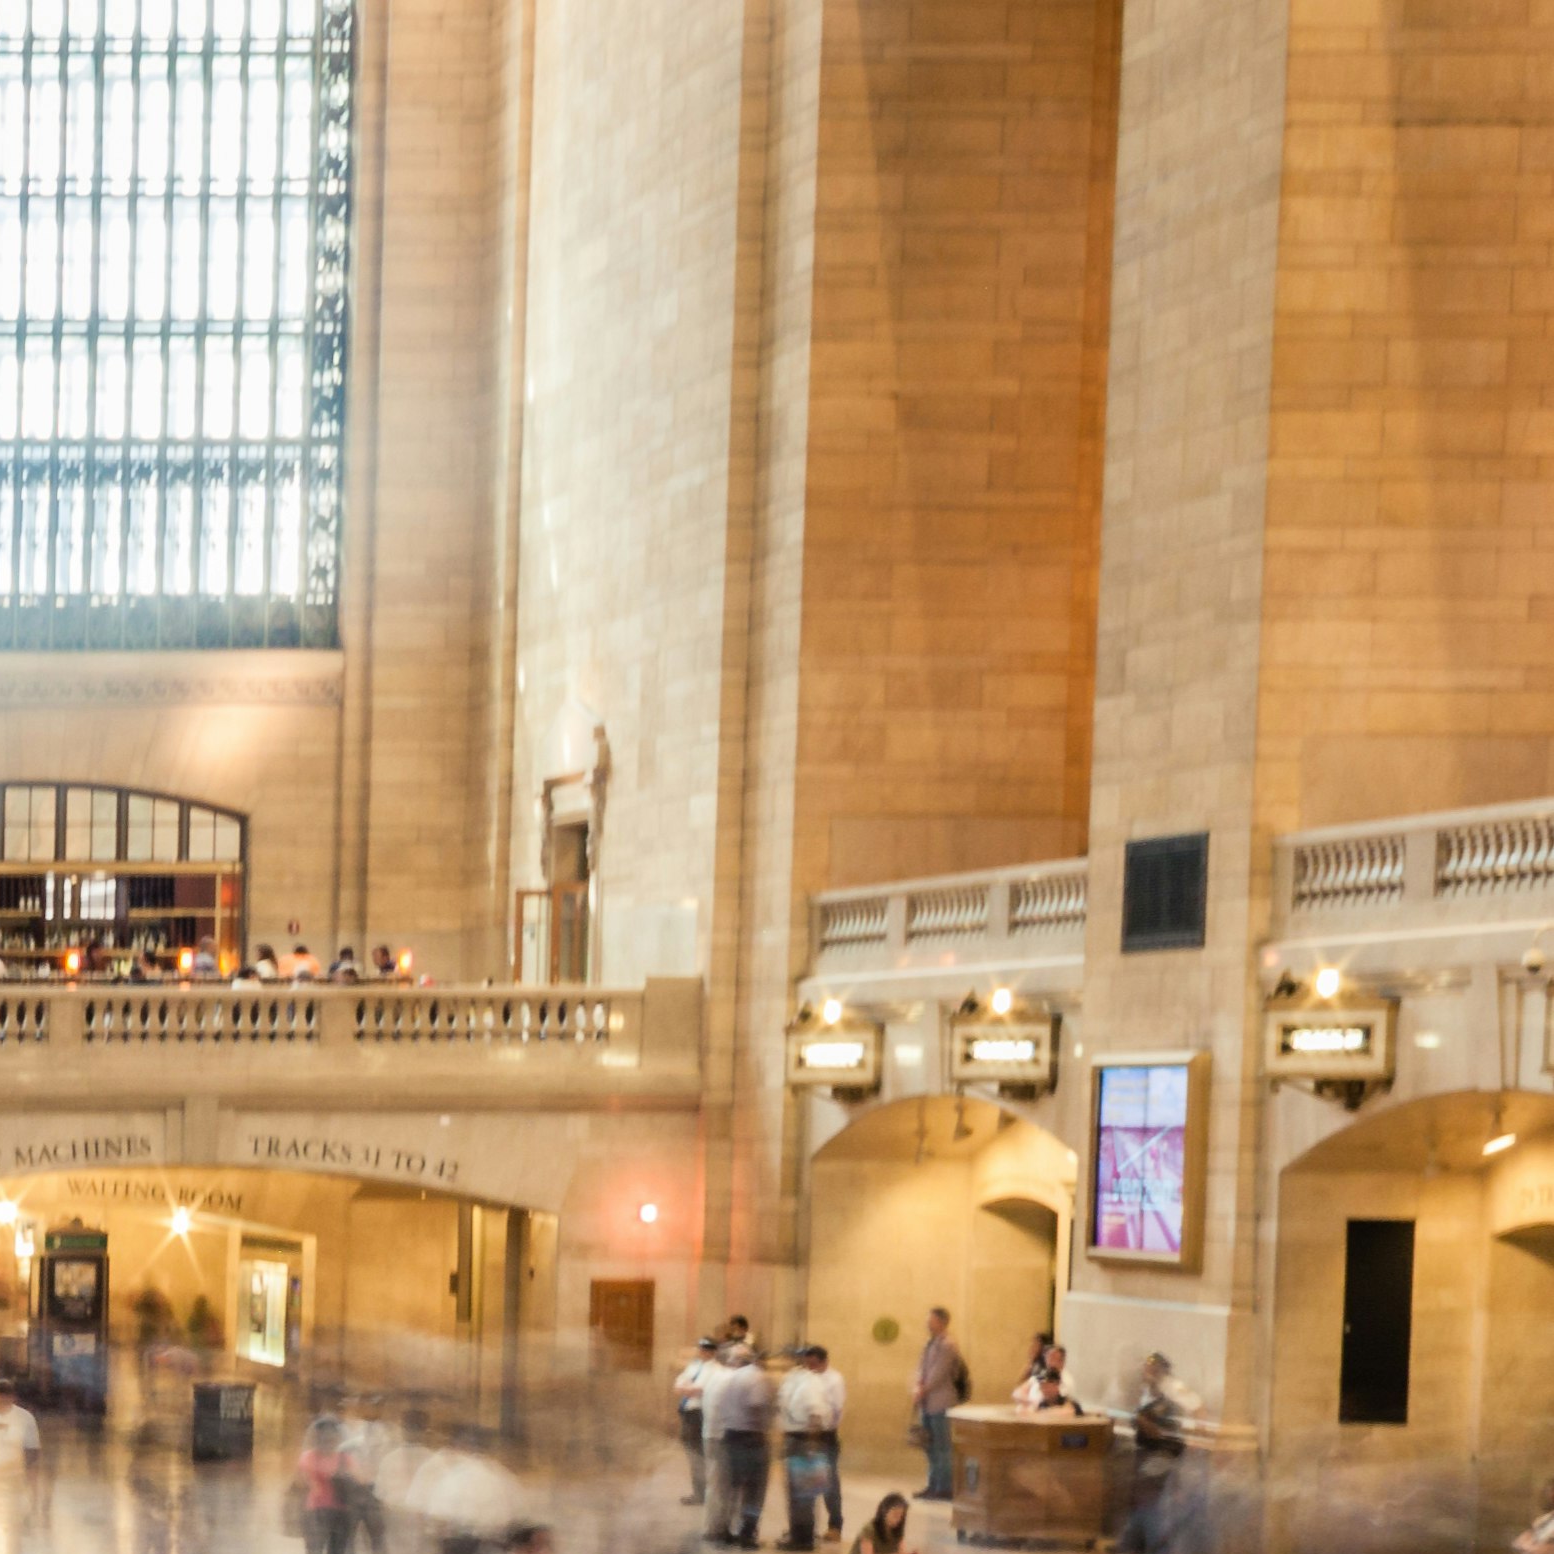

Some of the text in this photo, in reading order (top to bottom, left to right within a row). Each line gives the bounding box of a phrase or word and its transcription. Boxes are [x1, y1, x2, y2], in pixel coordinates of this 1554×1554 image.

[14, 1135, 152, 1168] MACHINES
[248, 1135, 351, 1163] TRACKS
[393, 1150, 427, 1175] TO
[67, 1176, 243, 1211] WAITING ROOM
